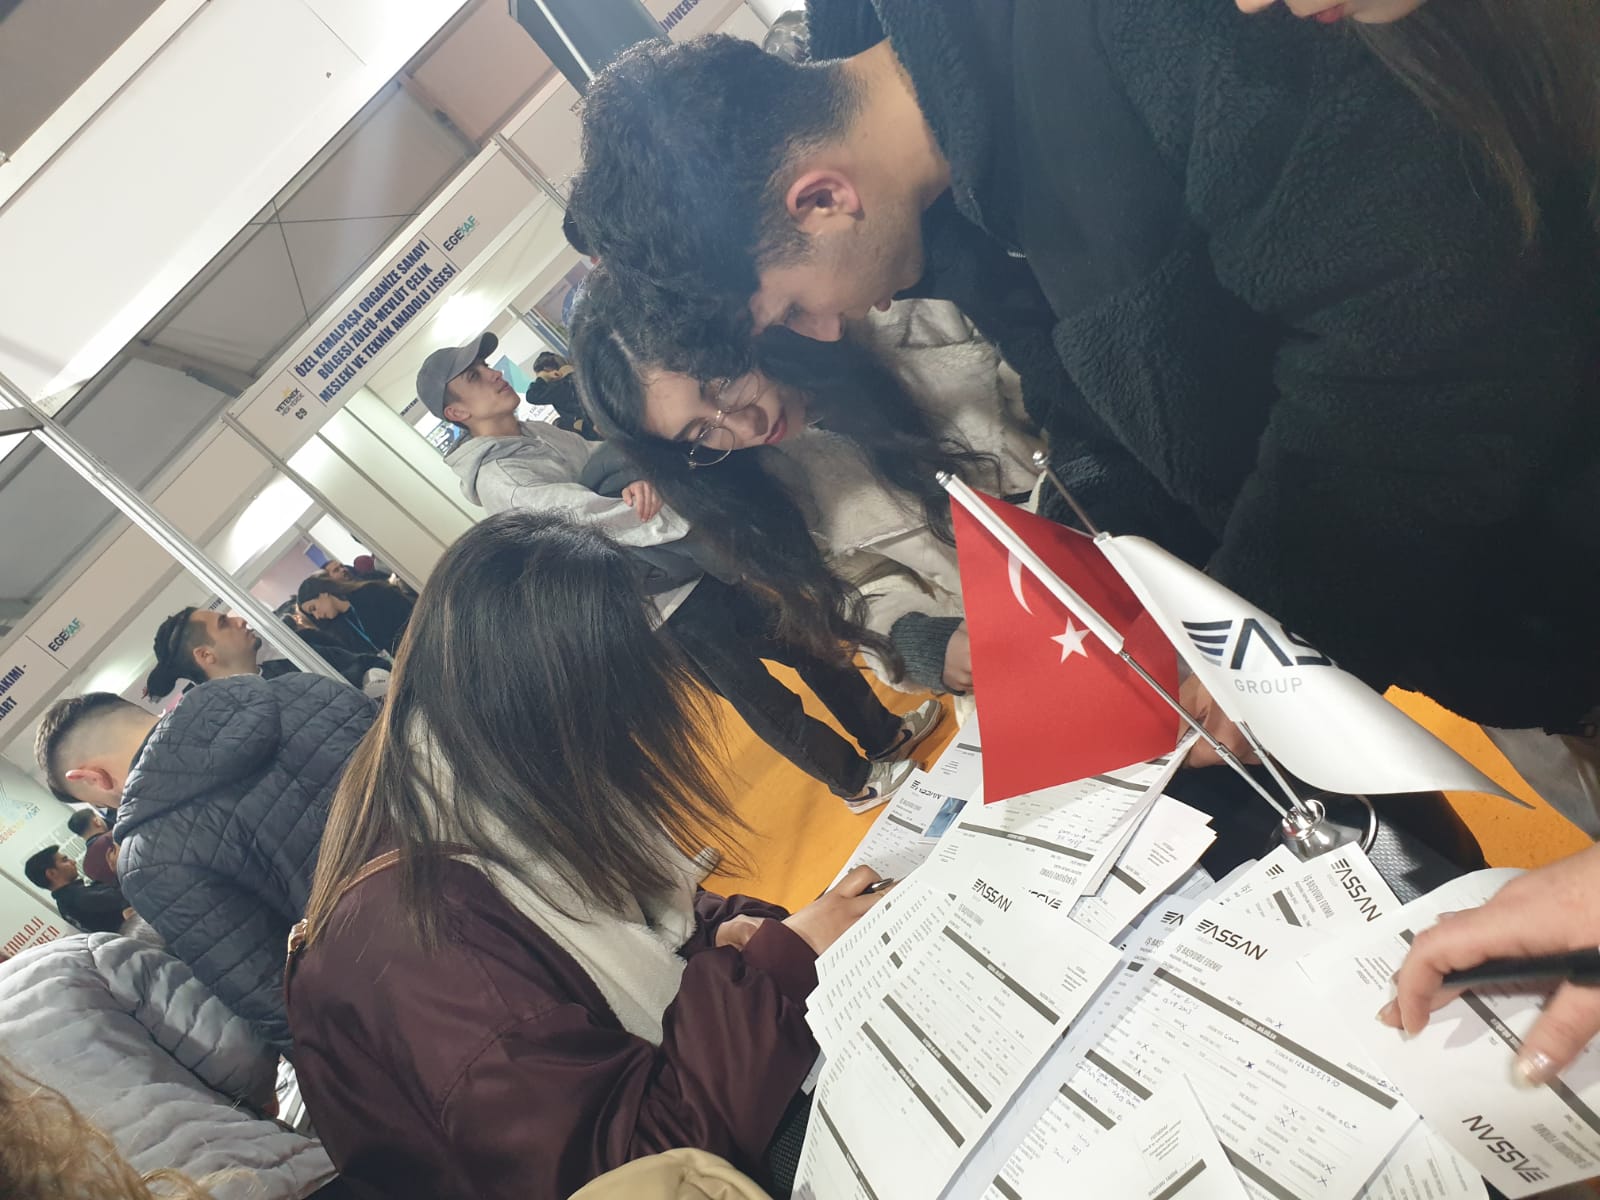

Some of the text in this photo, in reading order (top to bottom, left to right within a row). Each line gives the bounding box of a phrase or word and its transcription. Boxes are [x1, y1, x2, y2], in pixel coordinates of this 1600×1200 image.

[294, 239, 430, 377] ÖZEL KEMALPAŞA ORGANİZE SANAYİ
[317, 262, 433, 380] BÖLGESİ ZÜLFÜ-MEVLÜT ÇELİK
[319, 262, 456, 403] MESLEKİ VE TEKNİK ANADOLU LİSESİ
[295, 408, 307, 419] C9
[0, 665, 25, 696] AKIMI
[1234, 677, 1303, 694] GROUP
[971, 878, 1012, 912] EASSAN
[1330, 857, 1382, 922] EASSAN
[1194, 918, 1268, 960] EASSAN
[1461, 1114, 1549, 1183] EASSAN
